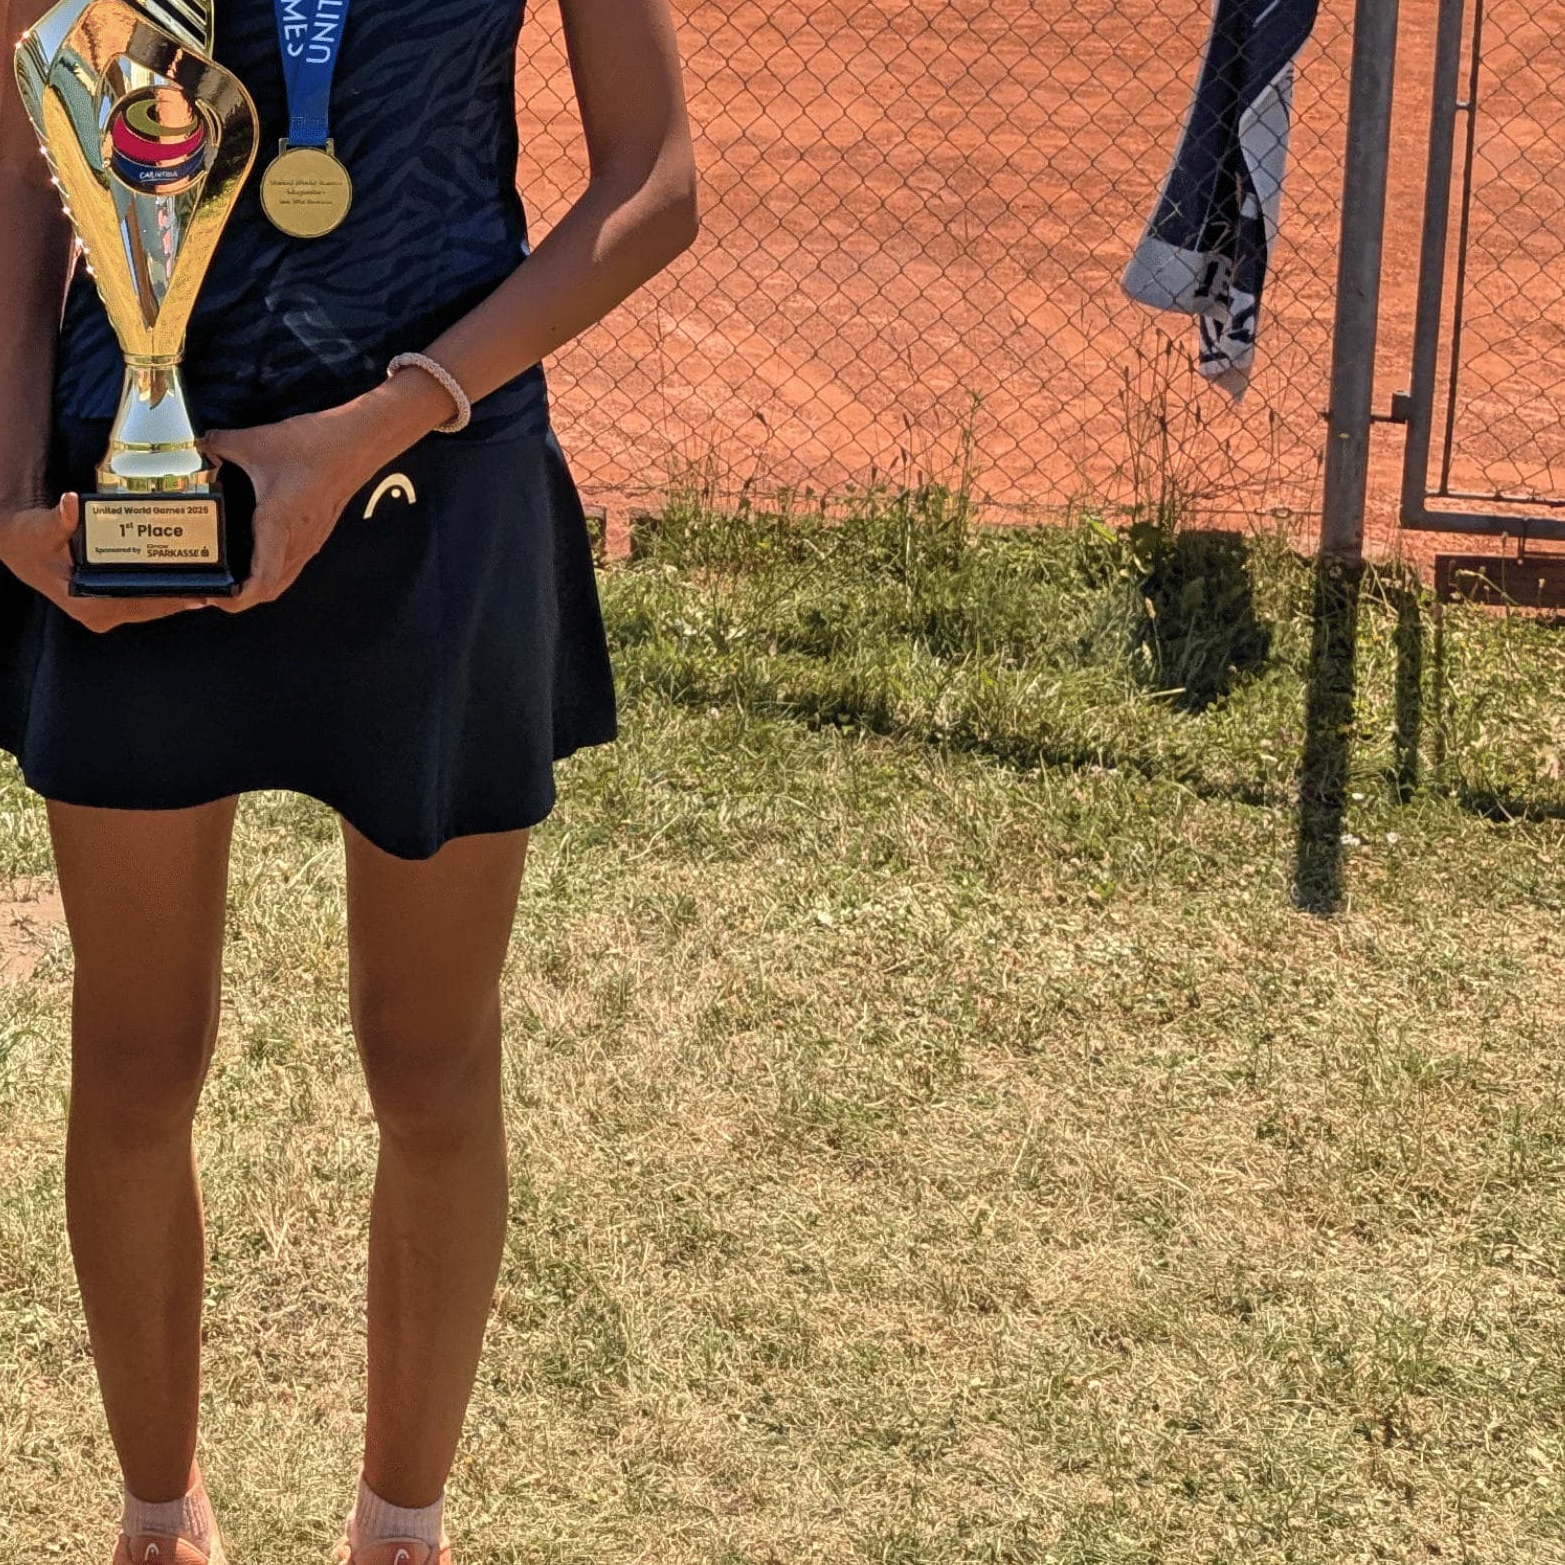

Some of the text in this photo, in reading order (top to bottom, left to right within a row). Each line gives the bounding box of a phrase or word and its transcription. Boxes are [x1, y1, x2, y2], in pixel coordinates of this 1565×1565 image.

[92, 506, 209, 515] United World Games 2025
[119, 522, 184, 537] 1st Place
[147, 549, 199, 558] SPARKASSE
